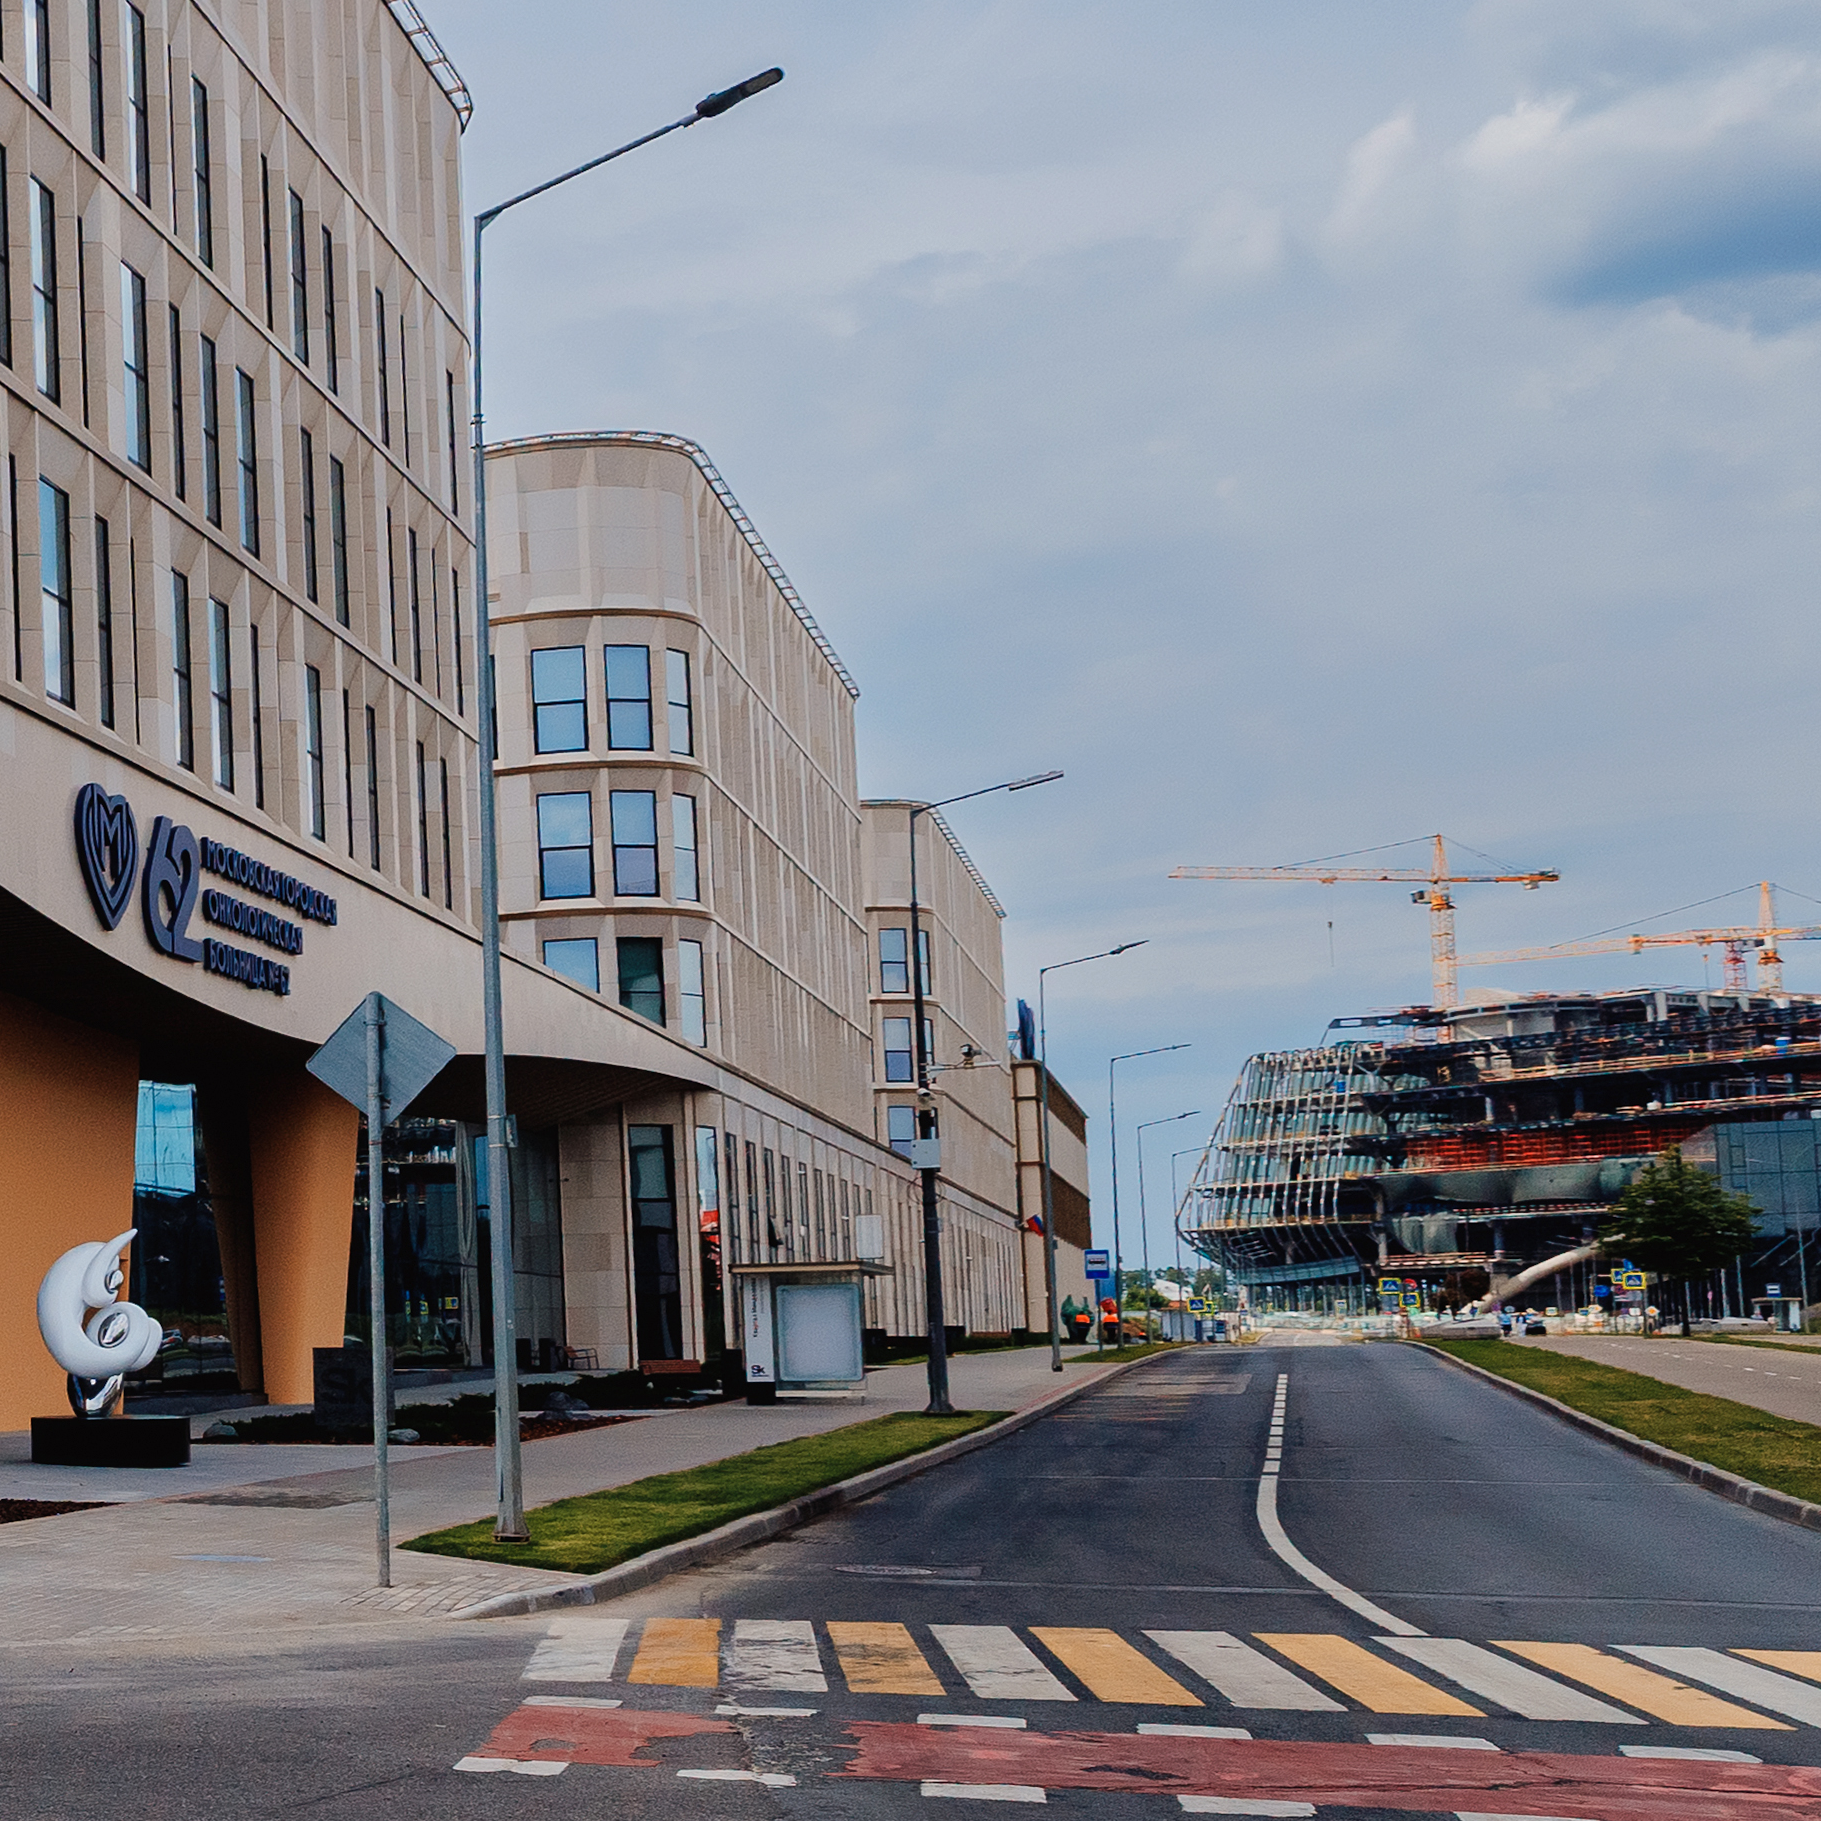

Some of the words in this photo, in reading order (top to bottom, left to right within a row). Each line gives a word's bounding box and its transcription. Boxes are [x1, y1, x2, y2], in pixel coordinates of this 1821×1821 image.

[201, 837, 281, 900] МОСКОВСКАЯ
[280, 871, 337, 926] ГОРОДСКАЯ
[202, 888, 303, 955] ОНКОЛОГИЧЕСКАЯ
[203, 938, 268, 989] БОЛЬНИЦА
